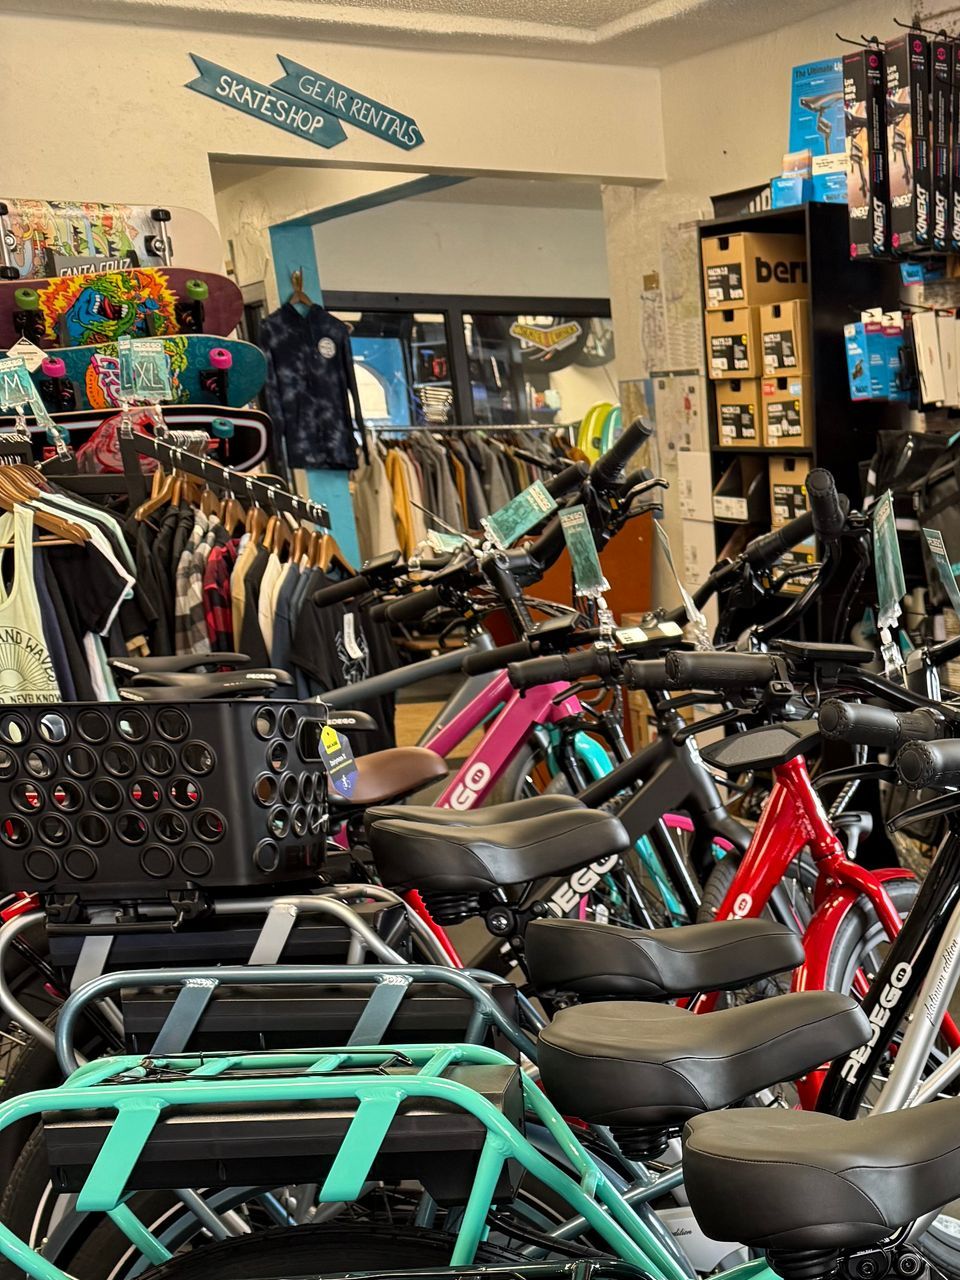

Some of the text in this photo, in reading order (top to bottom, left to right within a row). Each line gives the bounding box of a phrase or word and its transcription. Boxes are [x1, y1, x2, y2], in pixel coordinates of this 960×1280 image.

[298, 75, 419, 146] GEAR RENTALS
[4, 374, 27, 396] M
[134, 364, 163, 390] XL
[25, 637, 56, 683] WAVES
[924, 938, 959, 1027] platinum edition
[841, 962, 912, 1084] PEDEGO
